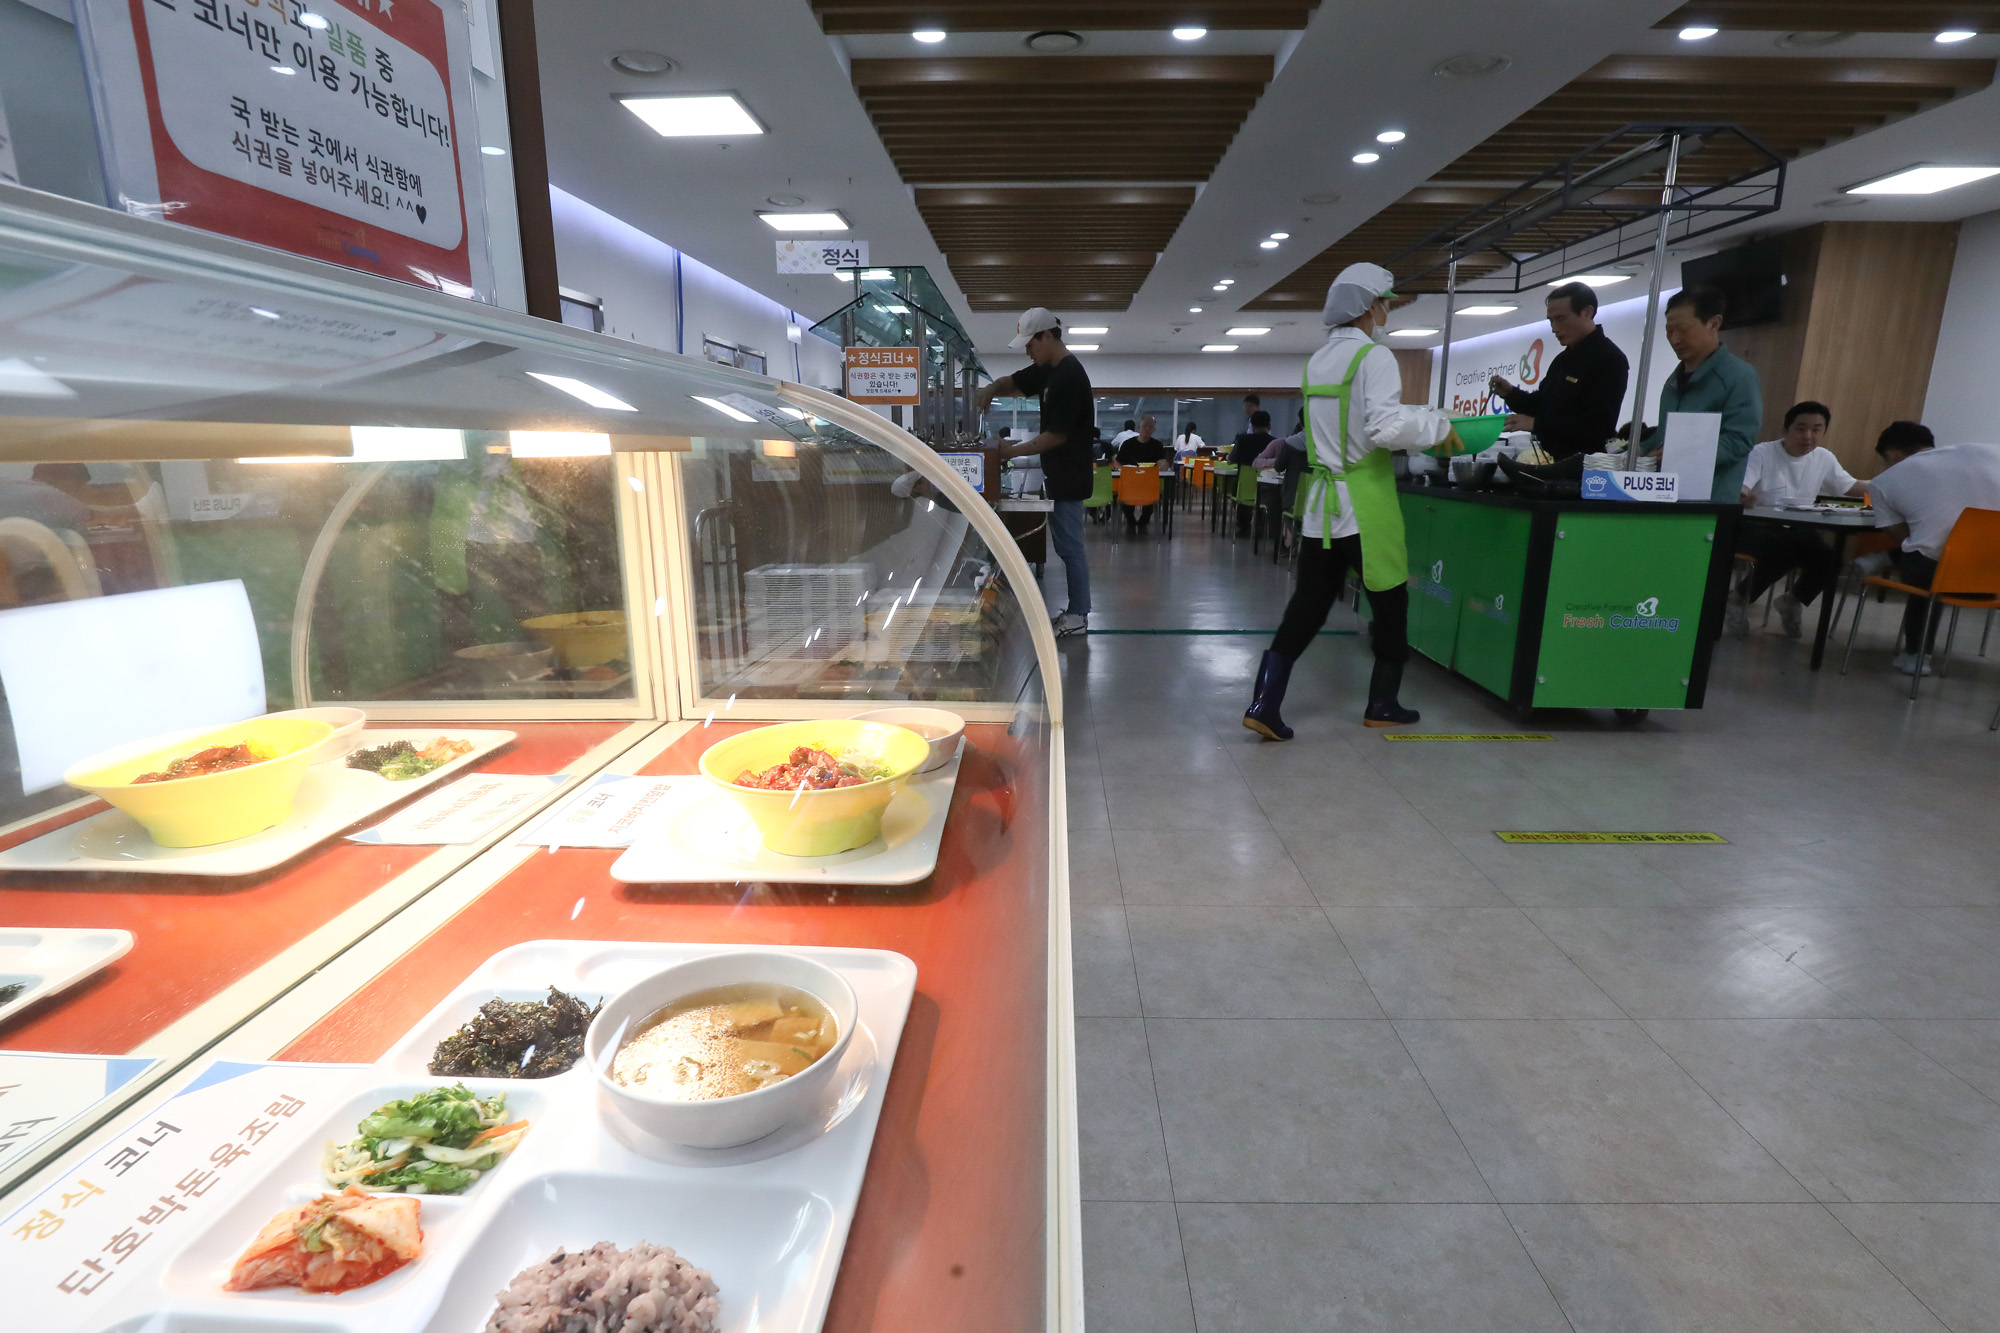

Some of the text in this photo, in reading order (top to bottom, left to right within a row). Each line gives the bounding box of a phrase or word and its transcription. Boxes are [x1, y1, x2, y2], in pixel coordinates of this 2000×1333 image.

[325, 17, 367, 69] 일품
[373, 47, 394, 84] 중
[194, 0, 451, 148] 코너만 이용 가능합니다!
[230, 96, 423, 198] 국 받는 곳에서 식권함에
[232, 131, 293, 177] 식권을
[301, 157, 390, 211] 넣어주세요!
[822, 248, 860, 266] 정식
[858, 352, 904, 365] 정식코너
[850, 372, 917, 380] 식권함은 국 받는 곳에
[1455, 369, 1486, 386] Creative
[1453, 390, 1488, 417] Fresh
[1624, 476, 1675, 491] PLUS 코너
[1565, 602, 1634, 611] Creative Partner
[1563, 613, 1680, 633] Fresh Catering
[587, 792, 615, 808] 코너
[12, 1120, 183, 1241] 정식 코너
[56, 1094, 306, 1296] 단호박돈육조림
